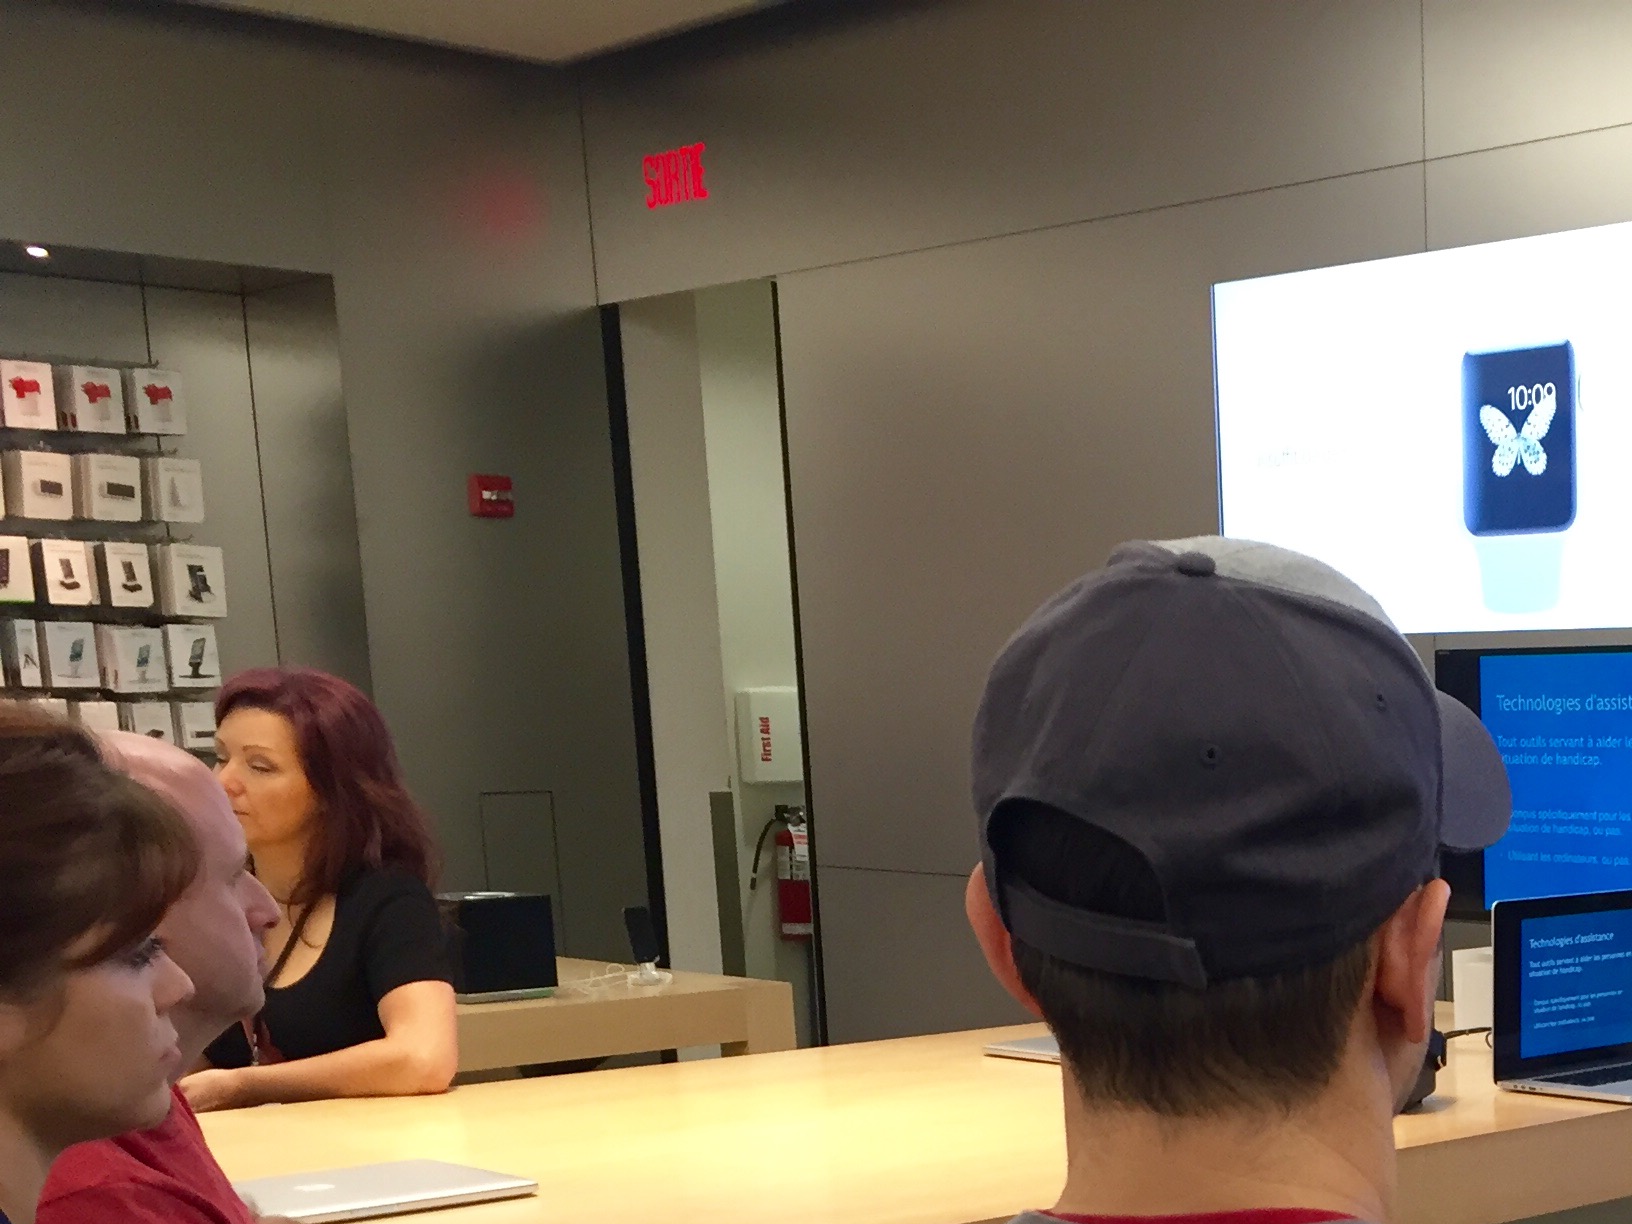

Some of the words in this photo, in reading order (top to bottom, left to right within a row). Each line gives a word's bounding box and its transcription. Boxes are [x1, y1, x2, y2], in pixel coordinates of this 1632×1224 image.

[642, 142, 709, 210] SORTIE
[1507, 382, 1556, 411] 10:09
[1496, 694, 1582, 715] Technologies
[759, 717, 770, 735] Aid
[761, 737, 772, 761] First
[1497, 735, 1517, 748] Tout
[1520, 735, 1547, 748] outils
[1549, 737, 1584, 748] servant
[1596, 736, 1621, 748] aider
[1502, 752, 1539, 765] ituation
[1541, 753, 1553, 765] de
[1529, 936, 1574, 950] Technologies
